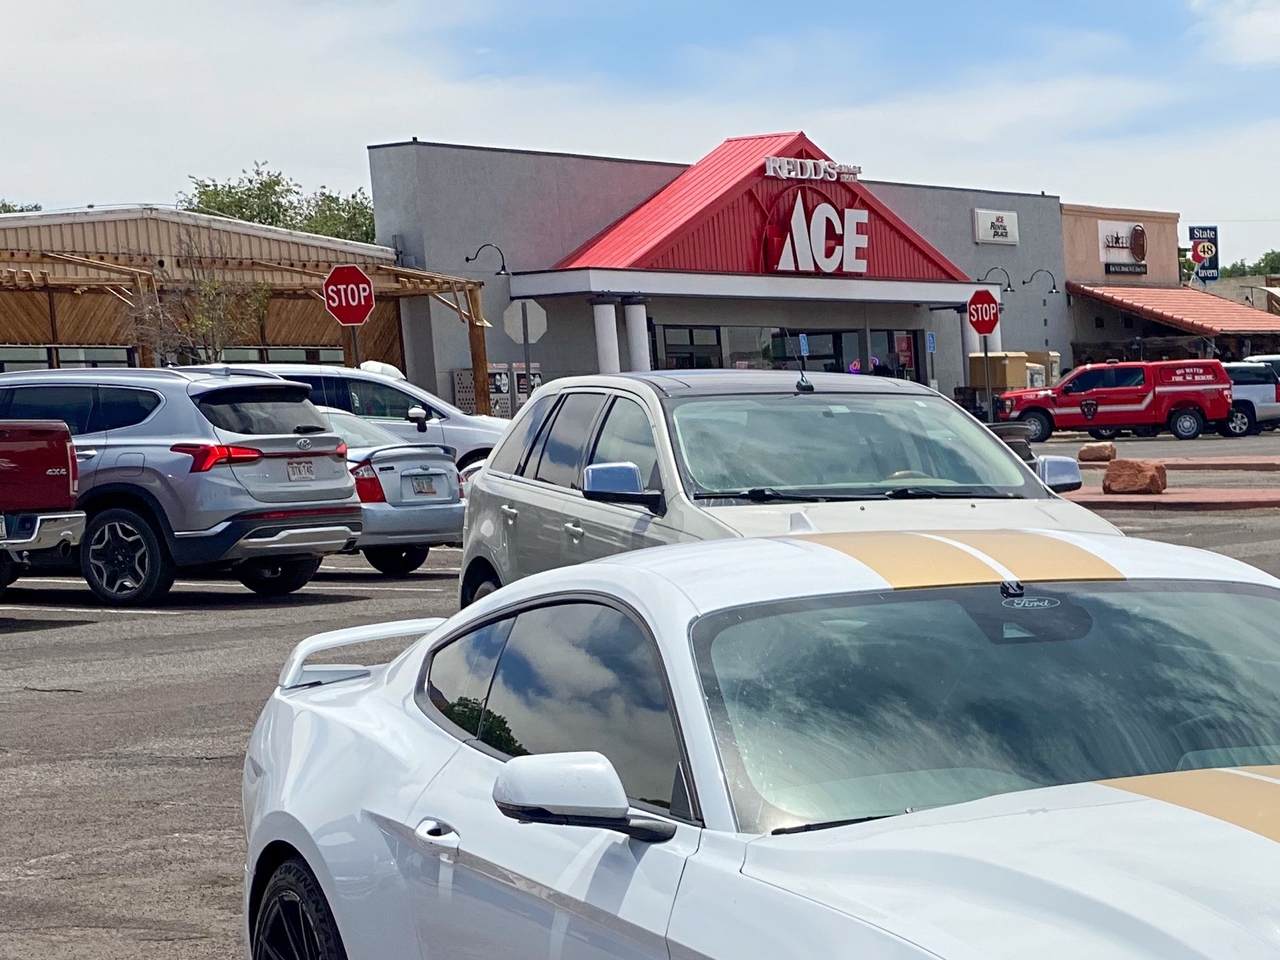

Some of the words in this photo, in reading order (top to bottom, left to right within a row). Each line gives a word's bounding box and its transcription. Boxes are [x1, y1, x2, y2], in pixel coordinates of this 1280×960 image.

[764, 156, 838, 182] REDD'S
[777, 189, 868, 273] ACE
[1193, 228, 1216, 239] State
[1199, 244, 1214, 256] 48
[1198, 267, 1218, 277] tavern
[327, 283, 370, 307] STOP
[970, 303, 997, 322] STOP
[1013, 598, 1050, 607] Ford
